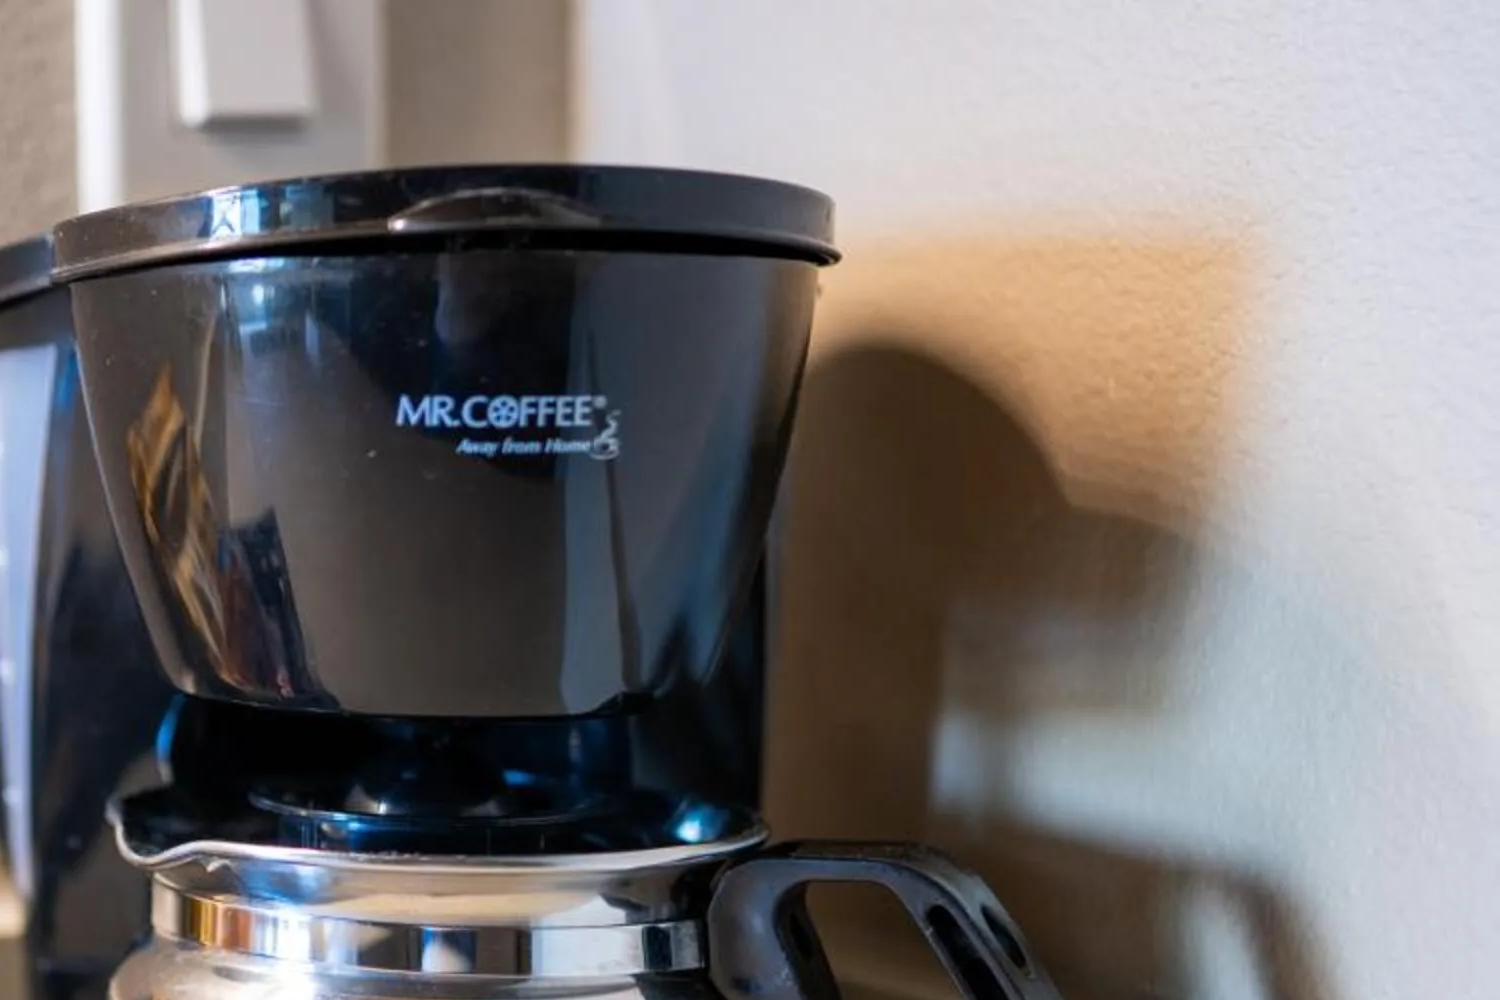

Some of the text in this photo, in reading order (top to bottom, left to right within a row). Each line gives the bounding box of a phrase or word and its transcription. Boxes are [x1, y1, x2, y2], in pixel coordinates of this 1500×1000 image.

[455, 436, 591, 458] Away from Home
